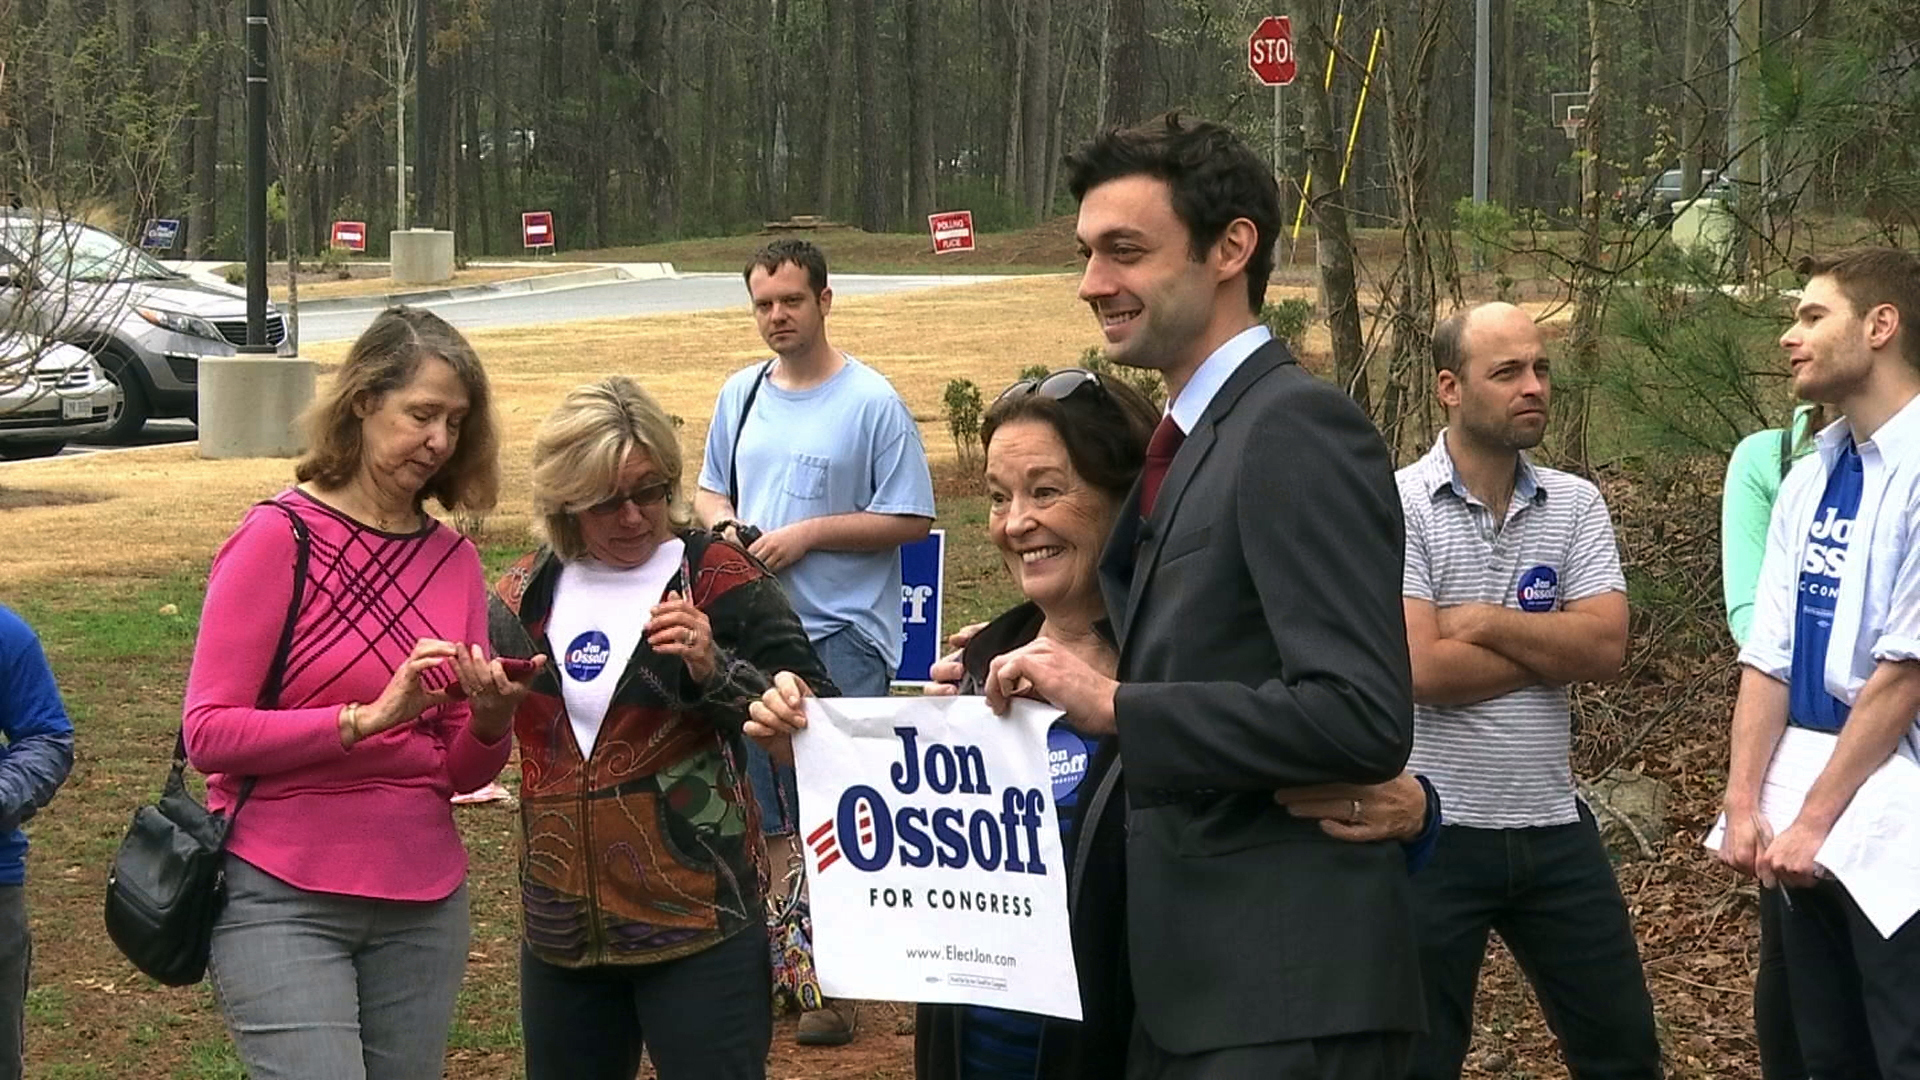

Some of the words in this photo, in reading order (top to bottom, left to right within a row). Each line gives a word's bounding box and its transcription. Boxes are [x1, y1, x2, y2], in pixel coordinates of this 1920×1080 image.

[1253, 38, 1293, 64] STO
[1810, 507, 1856, 544] Jo
[571, 649, 609, 664] Ossoff
[583, 642, 601, 654] Jon
[890, 726, 992, 795] Jon
[1047, 749, 1068, 763] on
[1048, 753, 1087, 777] soff
[837, 784, 1047, 875] Ossoff
[869, 888, 914, 908] FOR
[927, 889, 1033, 917] CONGRESS
[905, 944, 1018, 968] www.ElectJon.com
